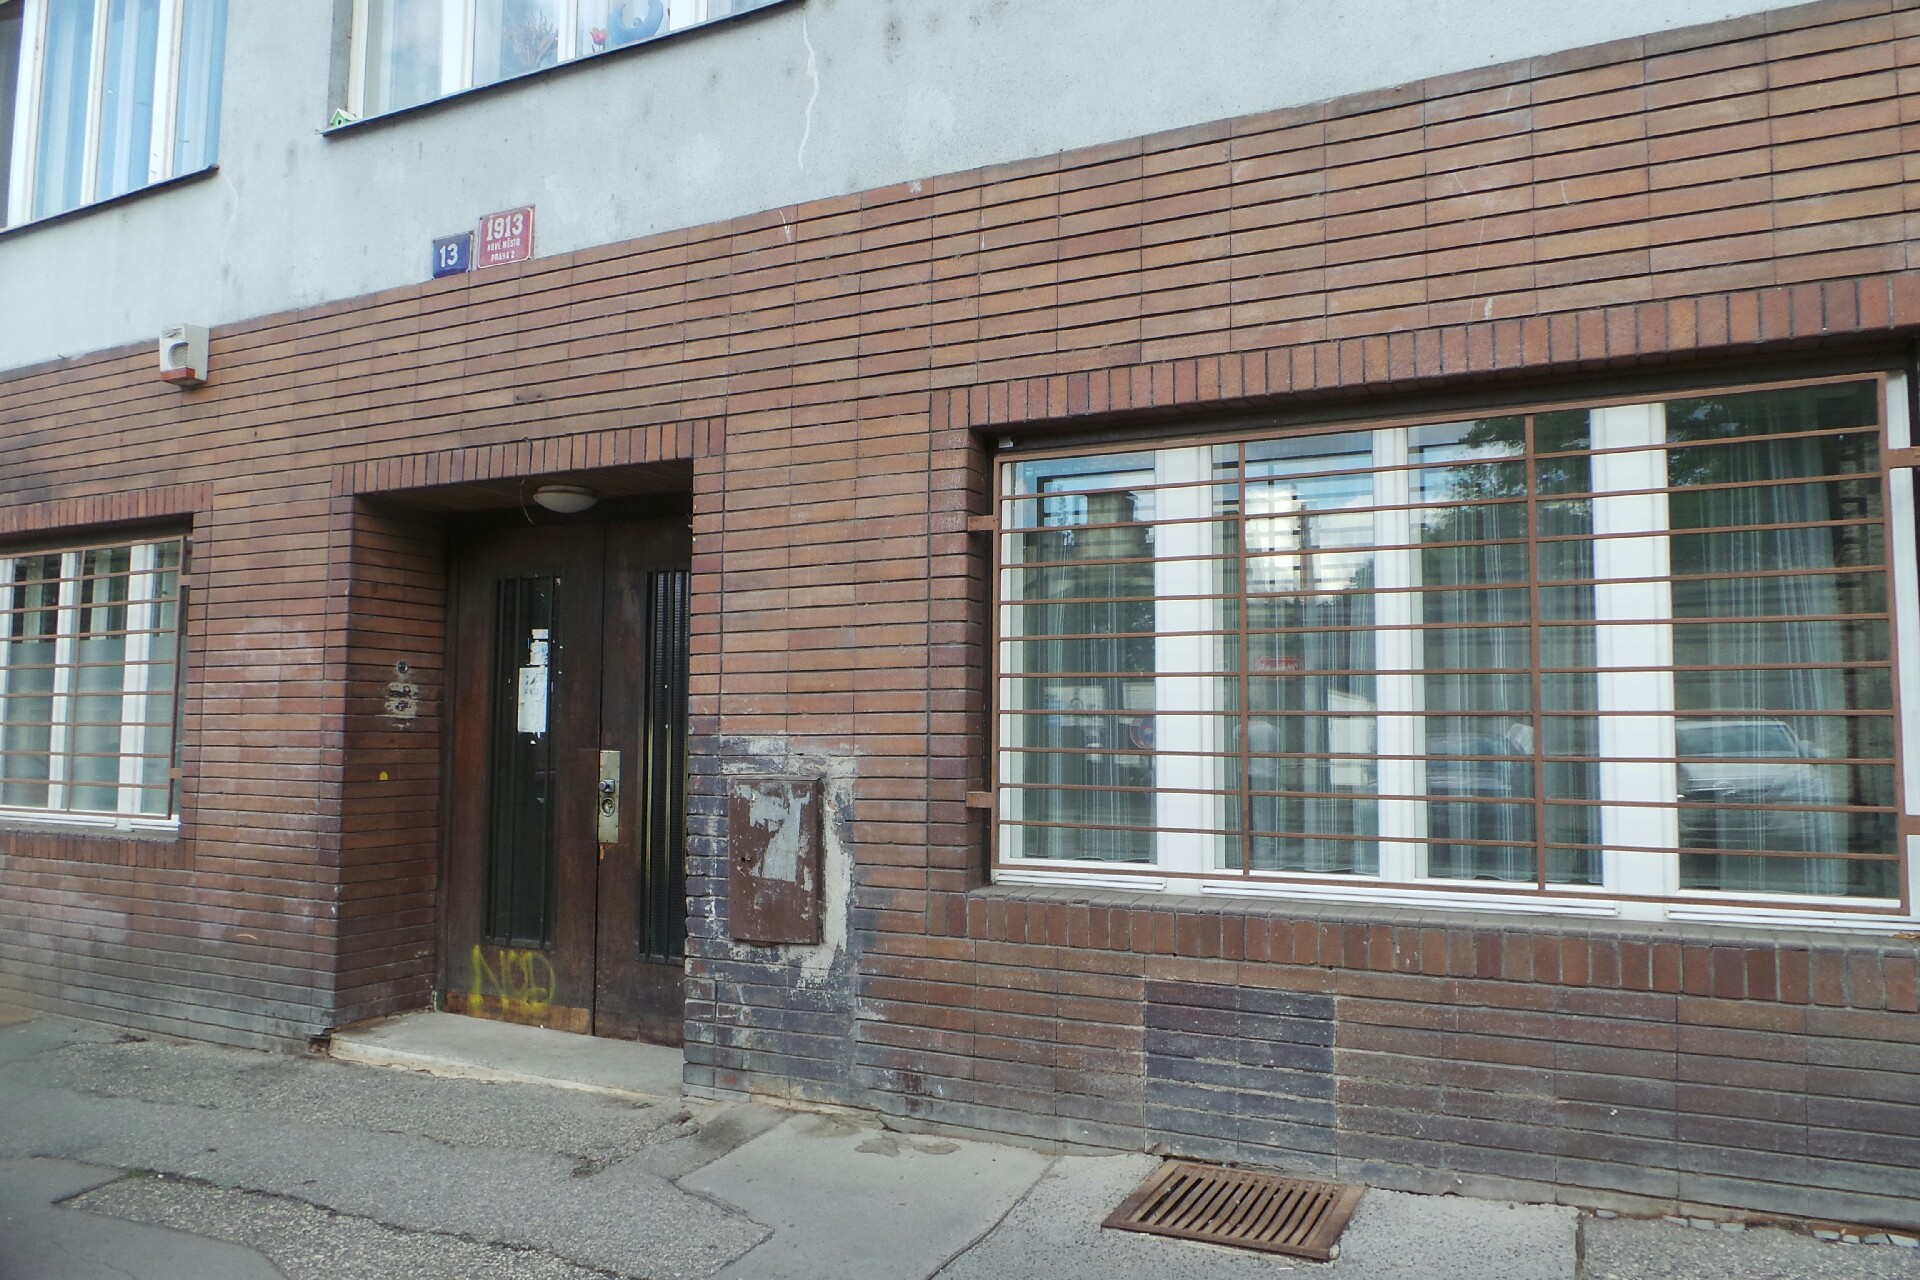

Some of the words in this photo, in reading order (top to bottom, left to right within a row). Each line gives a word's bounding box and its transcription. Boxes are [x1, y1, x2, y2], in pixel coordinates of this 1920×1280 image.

[486, 213, 523, 241] 1913
[487, 240, 502, 251] NOVÉ
[502, 238, 520, 250] MĚSTO
[440, 243, 459, 268] 13
[491, 252, 510, 262] PRAHA
[510, 250, 515, 259] 2
